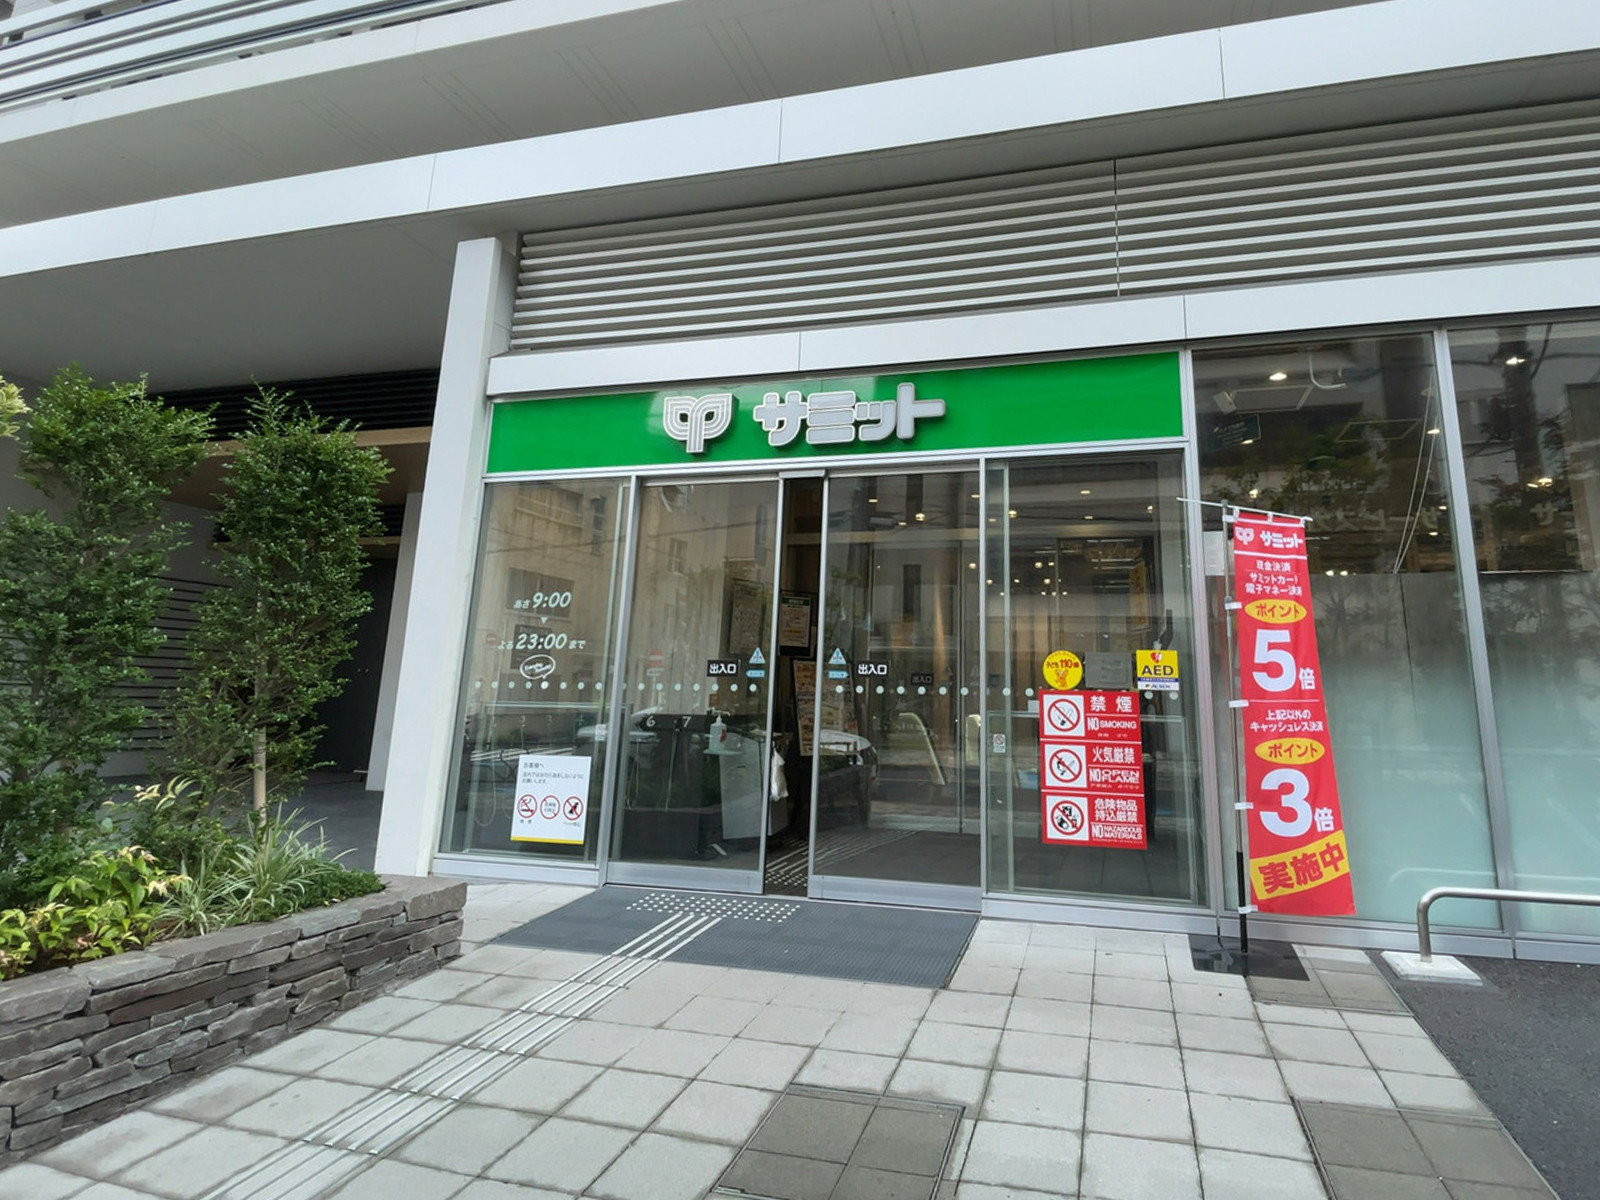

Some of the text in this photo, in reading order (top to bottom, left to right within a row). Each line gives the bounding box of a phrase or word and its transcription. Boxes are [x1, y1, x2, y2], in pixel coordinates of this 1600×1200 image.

[753, 382, 946, 446] サミット
[1260, 531, 1303, 548] サミット
[1256, 560, 1291, 572] 現金決済
[532, 592, 571, 609] 9:00
[1256, 604, 1300, 618] ポイント
[515, 633, 567, 650] 23:00
[1252, 629, 1316, 692] 5倍
[709, 663, 737, 674] 出入口
[857, 664, 888, 675] 出入口
[1141, 665, 1174, 676] AED
[646, 715, 656, 727] 6
[682, 716, 692, 727] 7
[1266, 709, 1311, 721] 上記以外の
[1087, 717, 1137, 731] NO SMOKING
[1250, 721, 1324, 732] キャッシュレス決済
[1092, 747, 1135, 764] 火気厳禁
[1268, 743, 1318, 758] ポイント
[1089, 768, 1140, 782] NO OPEN
[1101, 776, 1140, 784] FLAME
[1094, 799, 1138, 812] 危険物品
[1259, 768, 1335, 837] 3倍
[1094, 810, 1138, 823] 持込厳禁
[1091, 823, 1104, 838] NO
[1258, 842, 1345, 894] 実施中
